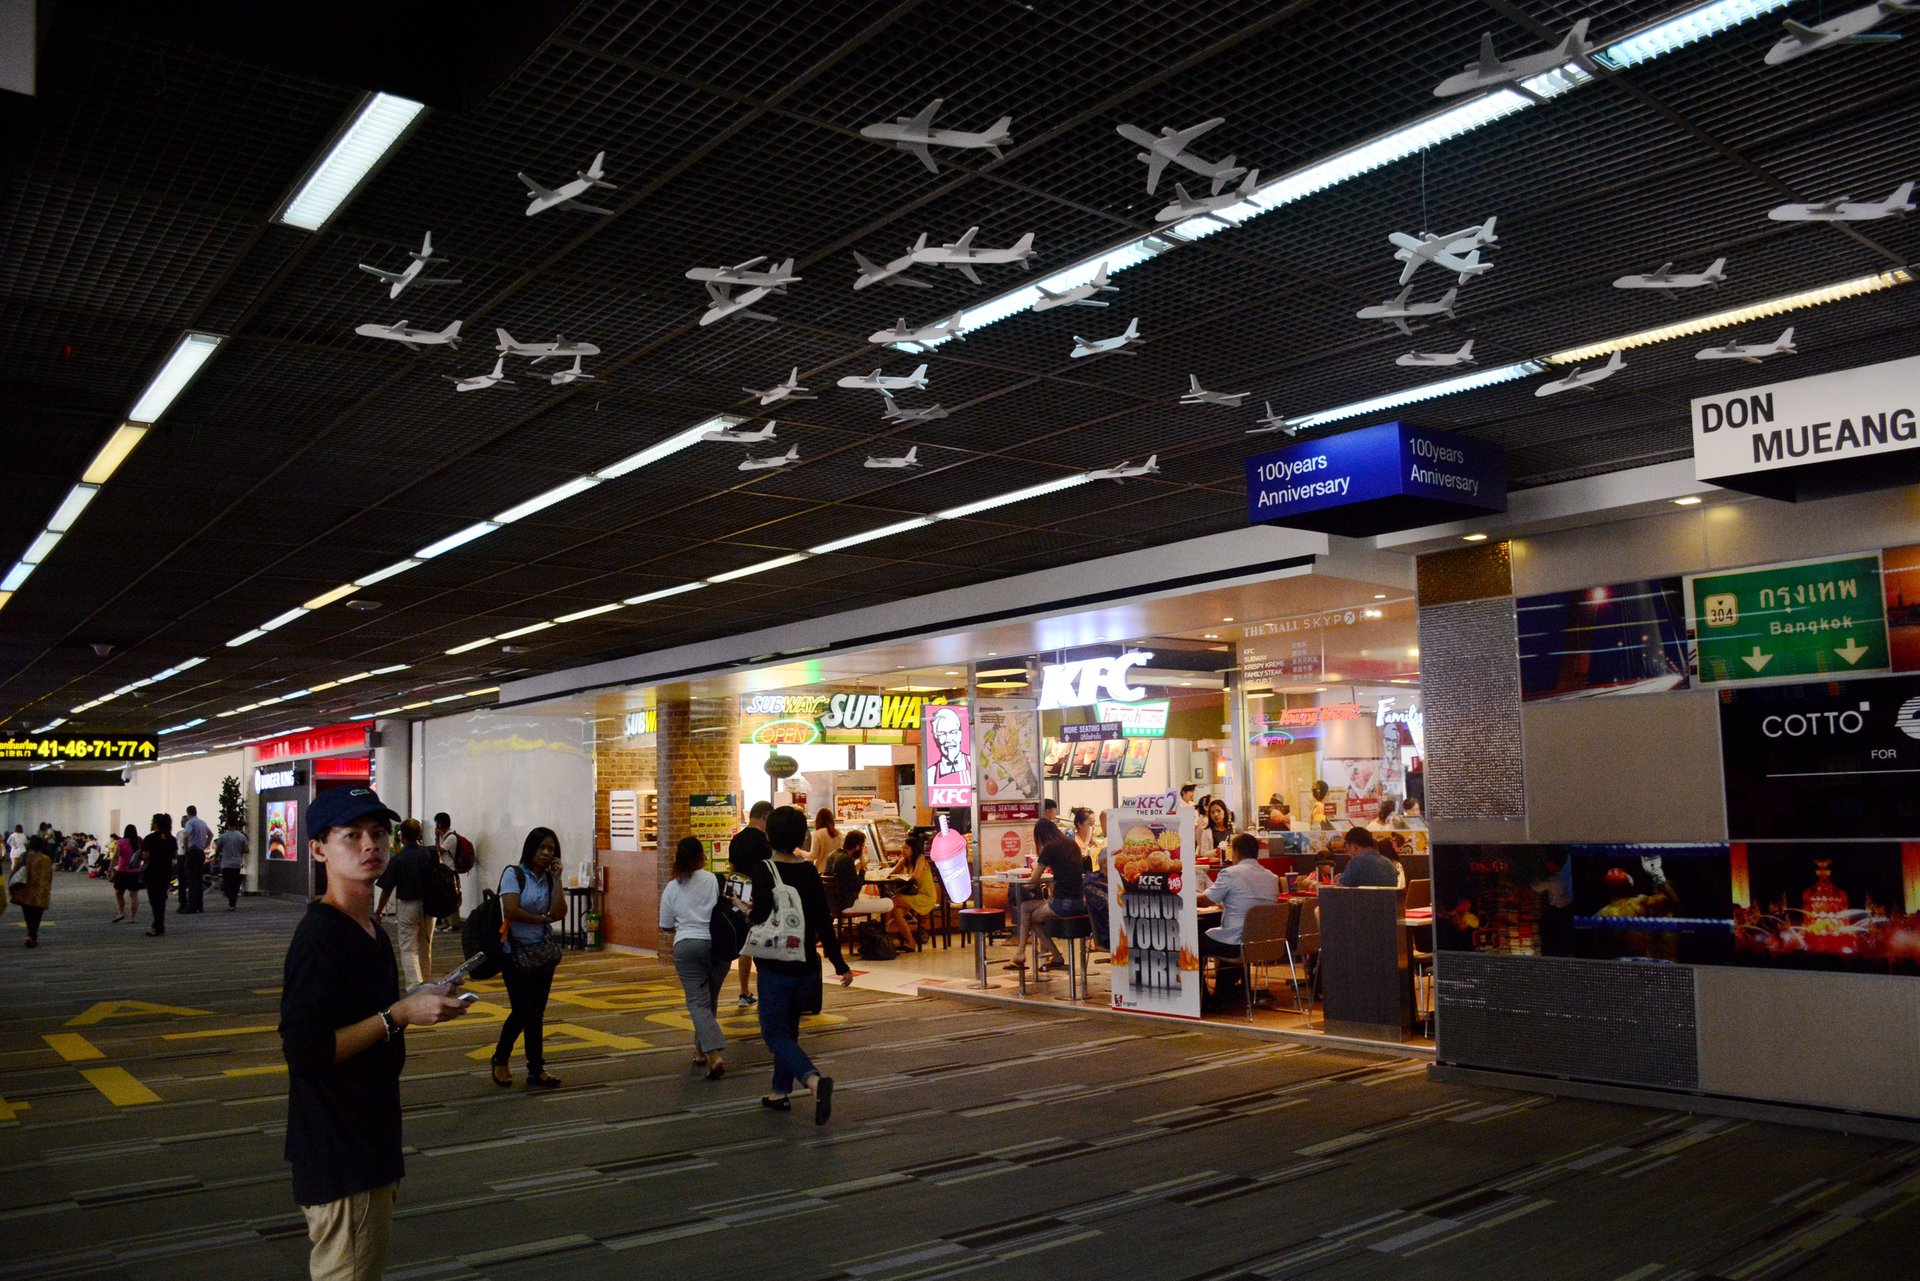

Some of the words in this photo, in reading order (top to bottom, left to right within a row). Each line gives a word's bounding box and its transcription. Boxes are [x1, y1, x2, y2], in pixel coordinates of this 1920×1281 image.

[1701, 392, 1774, 433] DON
[1752, 408, 1917, 463] MUEANG
[1409, 437, 1464, 464] 100years
[1257, 454, 1327, 483] 100years
[1410, 464, 1479, 496] Anniversary
[1257, 475, 1350, 508] Anniversary
[1759, 578, 1858, 613] กรุงเทพ
[1710, 607, 1734, 623] 304
[1770, 615, 1853, 636] Bangkok
[1243, 625, 1265, 638] THE
[1267, 620, 1300, 635] MALL
[1243, 648, 1255, 656] KFC
[1243, 654, 1268, 663] SUBWAY
[1243, 662, 1265, 671] KRISPY
[1264, 659, 1285, 669] KREME
[1244, 670, 1265, 679] FAMILY
[1264, 668, 1283, 677] STEAK
[1037, 652, 1151, 710] KFC
[746, 695, 826, 714] SUBWAY
[821, 693, 947, 729] SUBWA
[1376, 697, 1423, 728] Family
[761, 726, 808, 743] OPEN
[1063, 726, 1078, 734] MORE
[1079, 724, 1100, 733] SEATING
[1101, 723, 1118, 732] INSIDE
[1762, 710, 1863, 738] COTTO
[1871, 749, 1897, 760] FOR
[261, 772, 280, 790] BURGER
[280, 770, 294, 787] KING
[931, 788, 969, 805] KFC
[1019, 803, 1035, 811] INSIDE
[1122, 799, 1137, 807] NEW
[1137, 796, 1164, 808] KFC
[1166, 790, 1177, 815] 2
[1138, 875, 1163, 885] KFC
[1168, 877, 1181, 890] 245
[1124, 894, 1162, 919] TURN
[1162, 894, 1183, 920] UP
[1125, 918, 1180, 951] YOUR
[1128, 949, 1183, 991] FIRE
